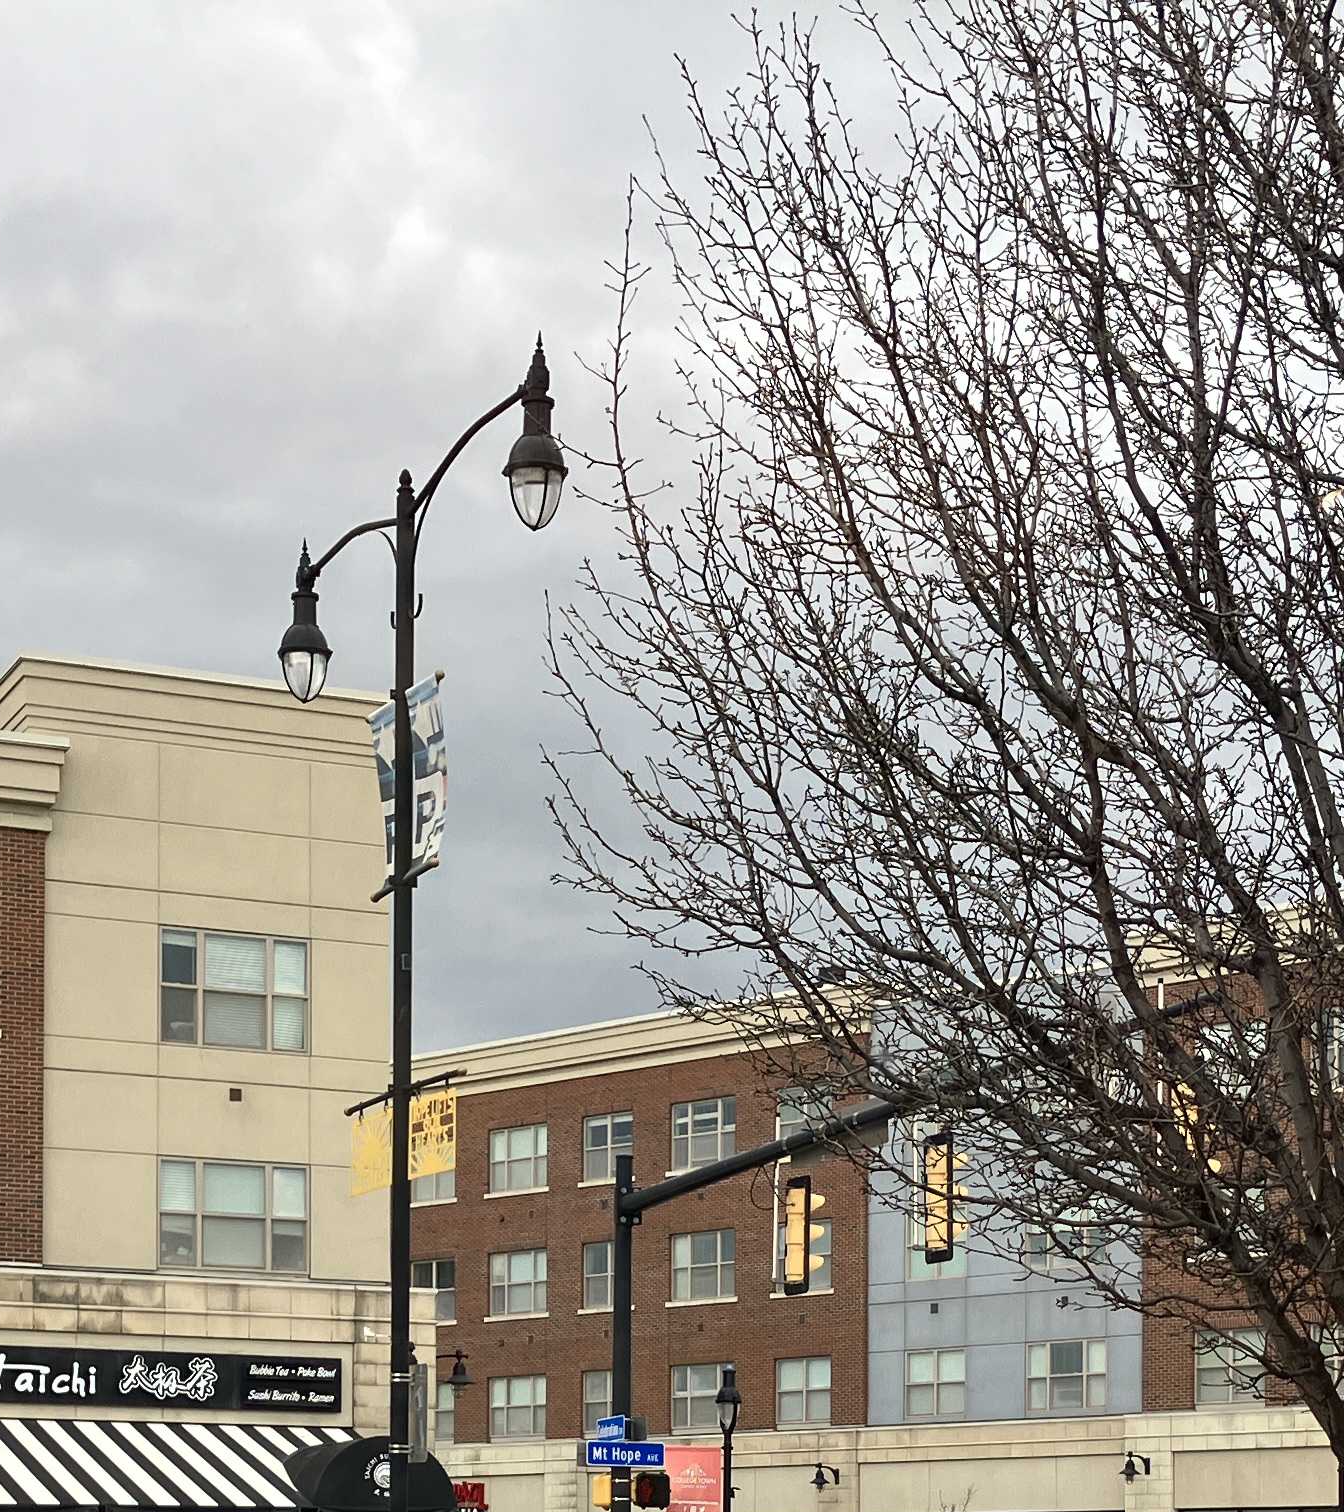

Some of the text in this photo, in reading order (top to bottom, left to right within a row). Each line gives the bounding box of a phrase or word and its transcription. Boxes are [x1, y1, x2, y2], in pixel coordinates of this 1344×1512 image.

[276, 1365, 290, 1376] Tea
[592, 1446, 607, 1461] Mt
[612, 1447, 641, 1463] Hope
[698, 1477, 717, 1485] TOWN
